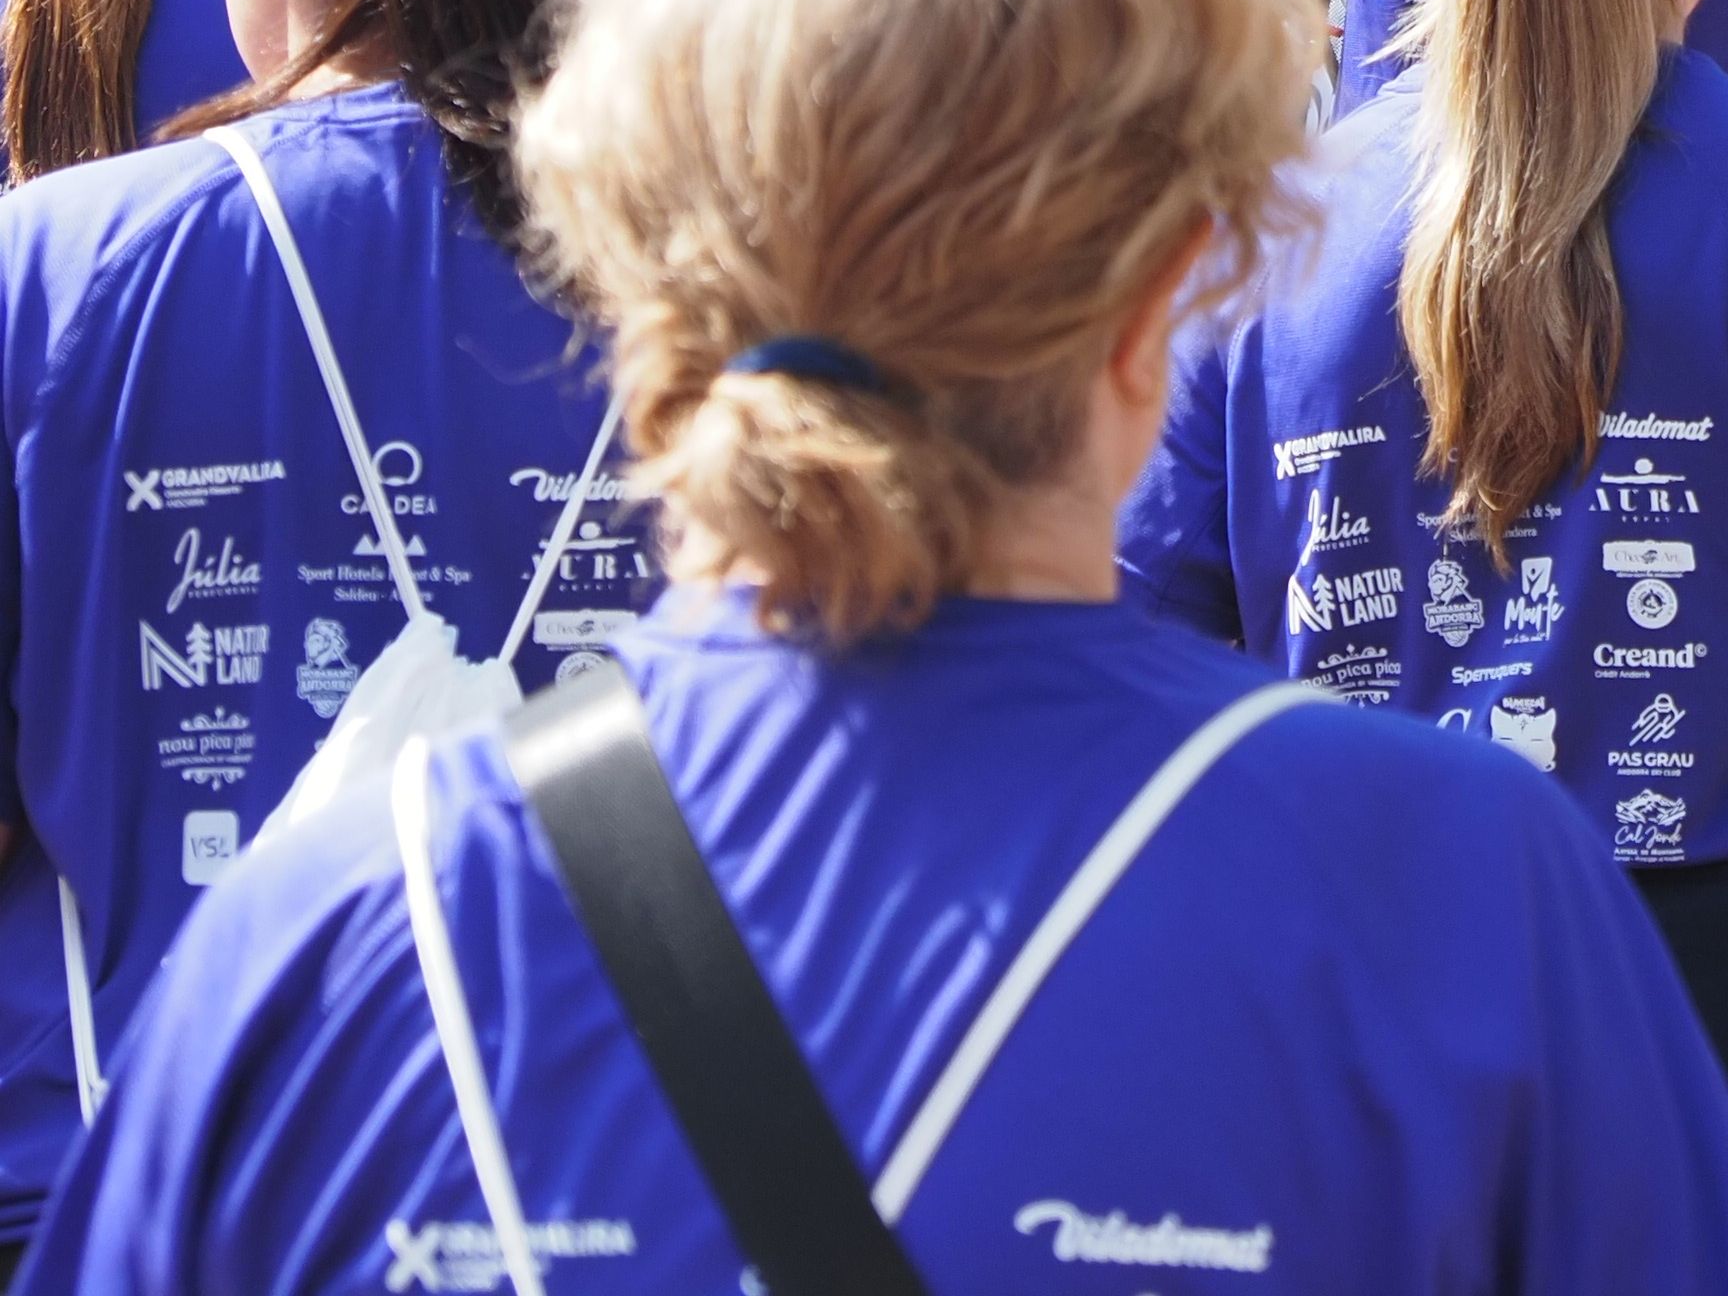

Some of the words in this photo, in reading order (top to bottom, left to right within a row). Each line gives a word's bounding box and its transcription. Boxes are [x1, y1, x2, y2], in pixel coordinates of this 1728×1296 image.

[1292, 426, 1386, 457] GRANDVALIRA
[162, 460, 287, 488] GRANDVALIRA
[1544, 504, 1562, 517] Spa
[1588, 488, 1700, 513] AURA
[1300, 489, 1370, 566] Júlia
[166, 527, 262, 615] Júlia
[298, 564, 334, 585] Sport
[338, 565, 384, 582] Hotels
[444, 567, 470, 584] Spa
[1335, 568, 1405, 596] NATUR
[1340, 593, 1398, 626] LAND
[1428, 611, 1480, 625] ANDORRA
[214, 624, 270, 656] NATUR
[216, 655, 263, 685] LAND
[1337, 665, 1372, 682] pica
[1375, 661, 1402, 678] pica
[1451, 662, 1533, 686] Sperruquers
[158, 737, 197, 754] nou
[200, 734, 232, 755] pica
[1608, 752, 1642, 767] PAS
[1644, 753, 1693, 768] GRAU
